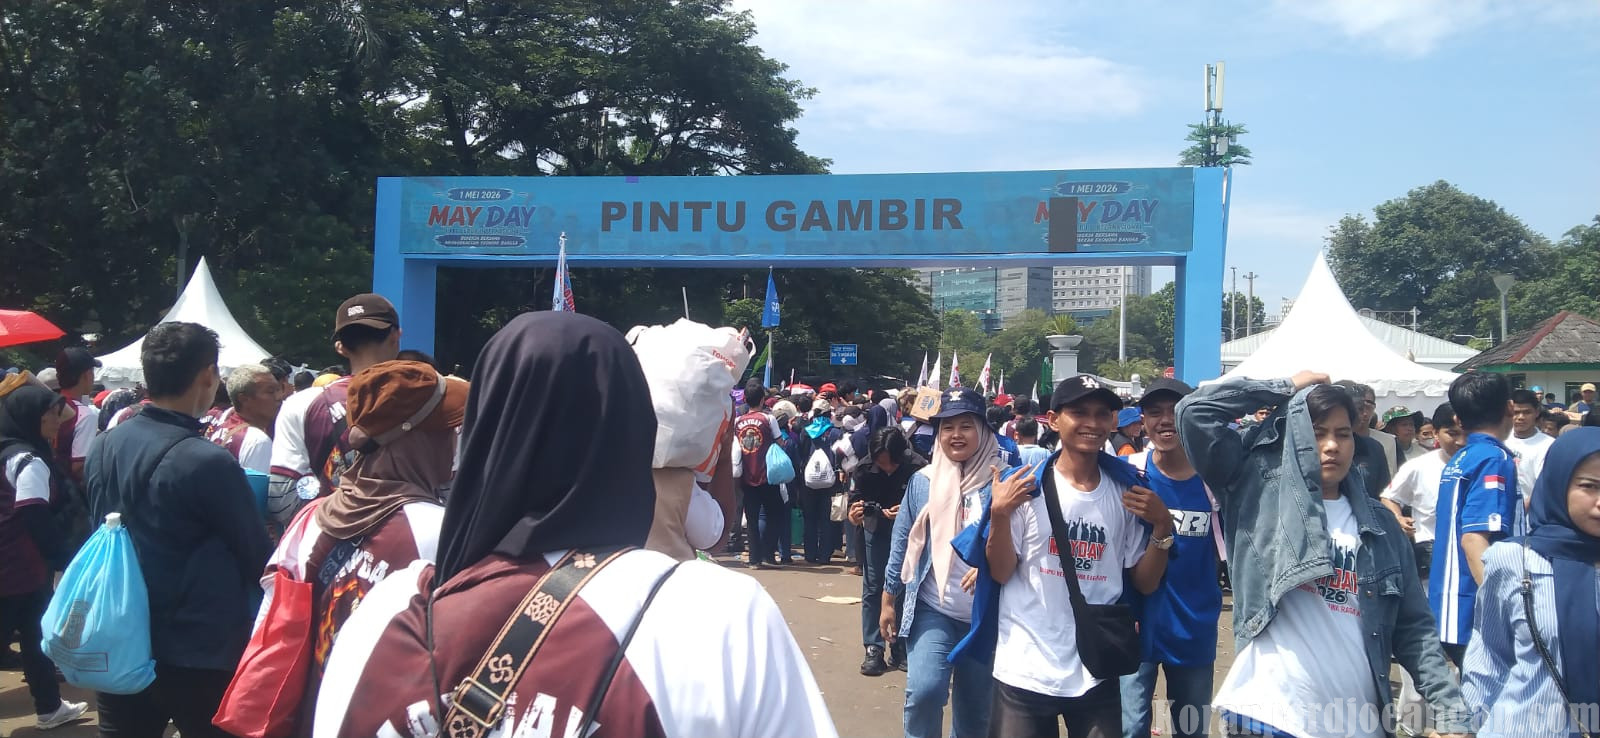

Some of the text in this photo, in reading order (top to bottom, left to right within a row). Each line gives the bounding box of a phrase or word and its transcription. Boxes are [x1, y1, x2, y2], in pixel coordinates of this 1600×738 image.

[465, 191, 480, 199] MEI
[481, 190, 501, 199] 2026
[1077, 184, 1094, 193] MEI
[1095, 183, 1118, 193] 2026
[427, 204, 537, 228] MAY DAY
[601, 198, 964, 233] PINTU GAMBIR
[1034, 199, 1160, 224] MY DAY
[1049, 537, 1107, 561] MYDAY
